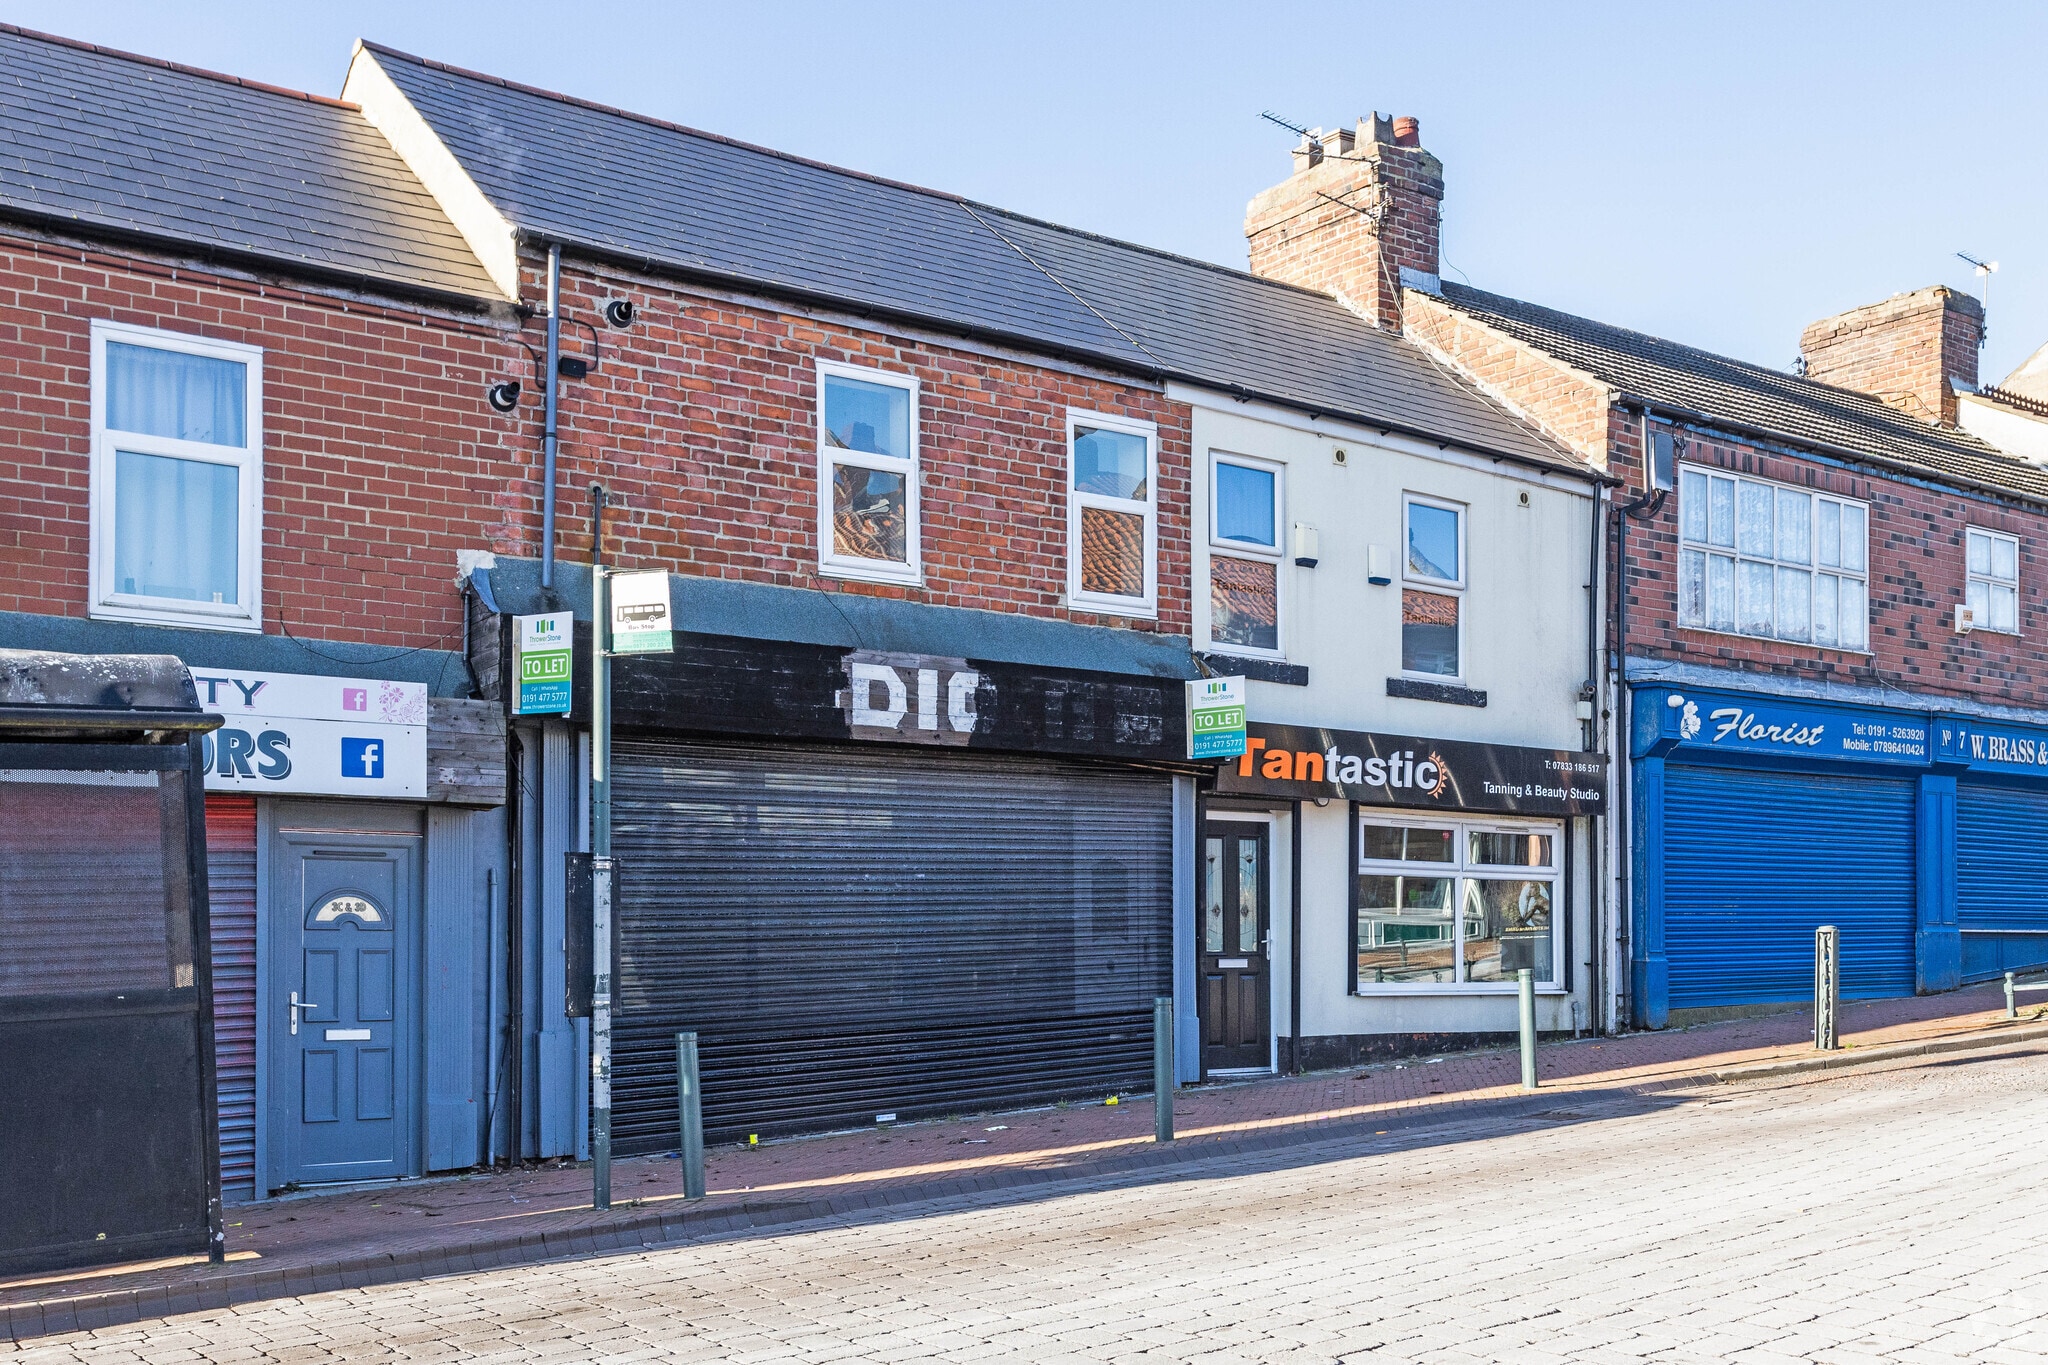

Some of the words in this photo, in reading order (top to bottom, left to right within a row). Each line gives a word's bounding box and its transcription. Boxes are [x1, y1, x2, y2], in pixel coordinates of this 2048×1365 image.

[529, 634, 562, 644] ThrowerStone
[525, 660, 541, 675] TO
[544, 658, 565, 673] LET
[522, 694, 537, 703] 0191
[538, 692, 551, 702] 477
[551, 691, 568, 701] 5777
[1200, 693, 1235, 702] ThrowerStone
[1196, 715, 1214, 727] TO
[1218, 712, 1239, 725] LET
[1710, 708, 1825, 746] Florist
[1852, 723, 1867, 735] Tel:
[1868, 726, 1886, 738] 0191
[1892, 728, 1925, 741] 5263920
[1959, 731, 1966, 750] 7
[1194, 742, 1210, 750] 0191
[1212, 740, 1224, 749] 477
[1226, 739, 1243, 747] 5777
[1843, 738, 1872, 752] Mobile:
[1873, 741, 1925, 756] 07896410424
[1971, 734, 1986, 759] W.
[1988, 736, 2035, 764] BRASS
[2037, 741, 2048, 765] &
[203, 728, 292, 780] RS
[1238, 737, 1438, 790] Tantastic
[1545, 760, 1551, 770] T:
[1552, 761, 1573, 771] 07833
[1575, 763, 1587, 772] 186
[1588, 764, 1600, 773] 517
[1483, 781, 1523, 798] Tanning
[1525, 784, 1533, 796] &
[1535, 784, 1568, 801] Beauty
[1570, 787, 1600, 800] Studio
[345, 902, 352, 912] &
